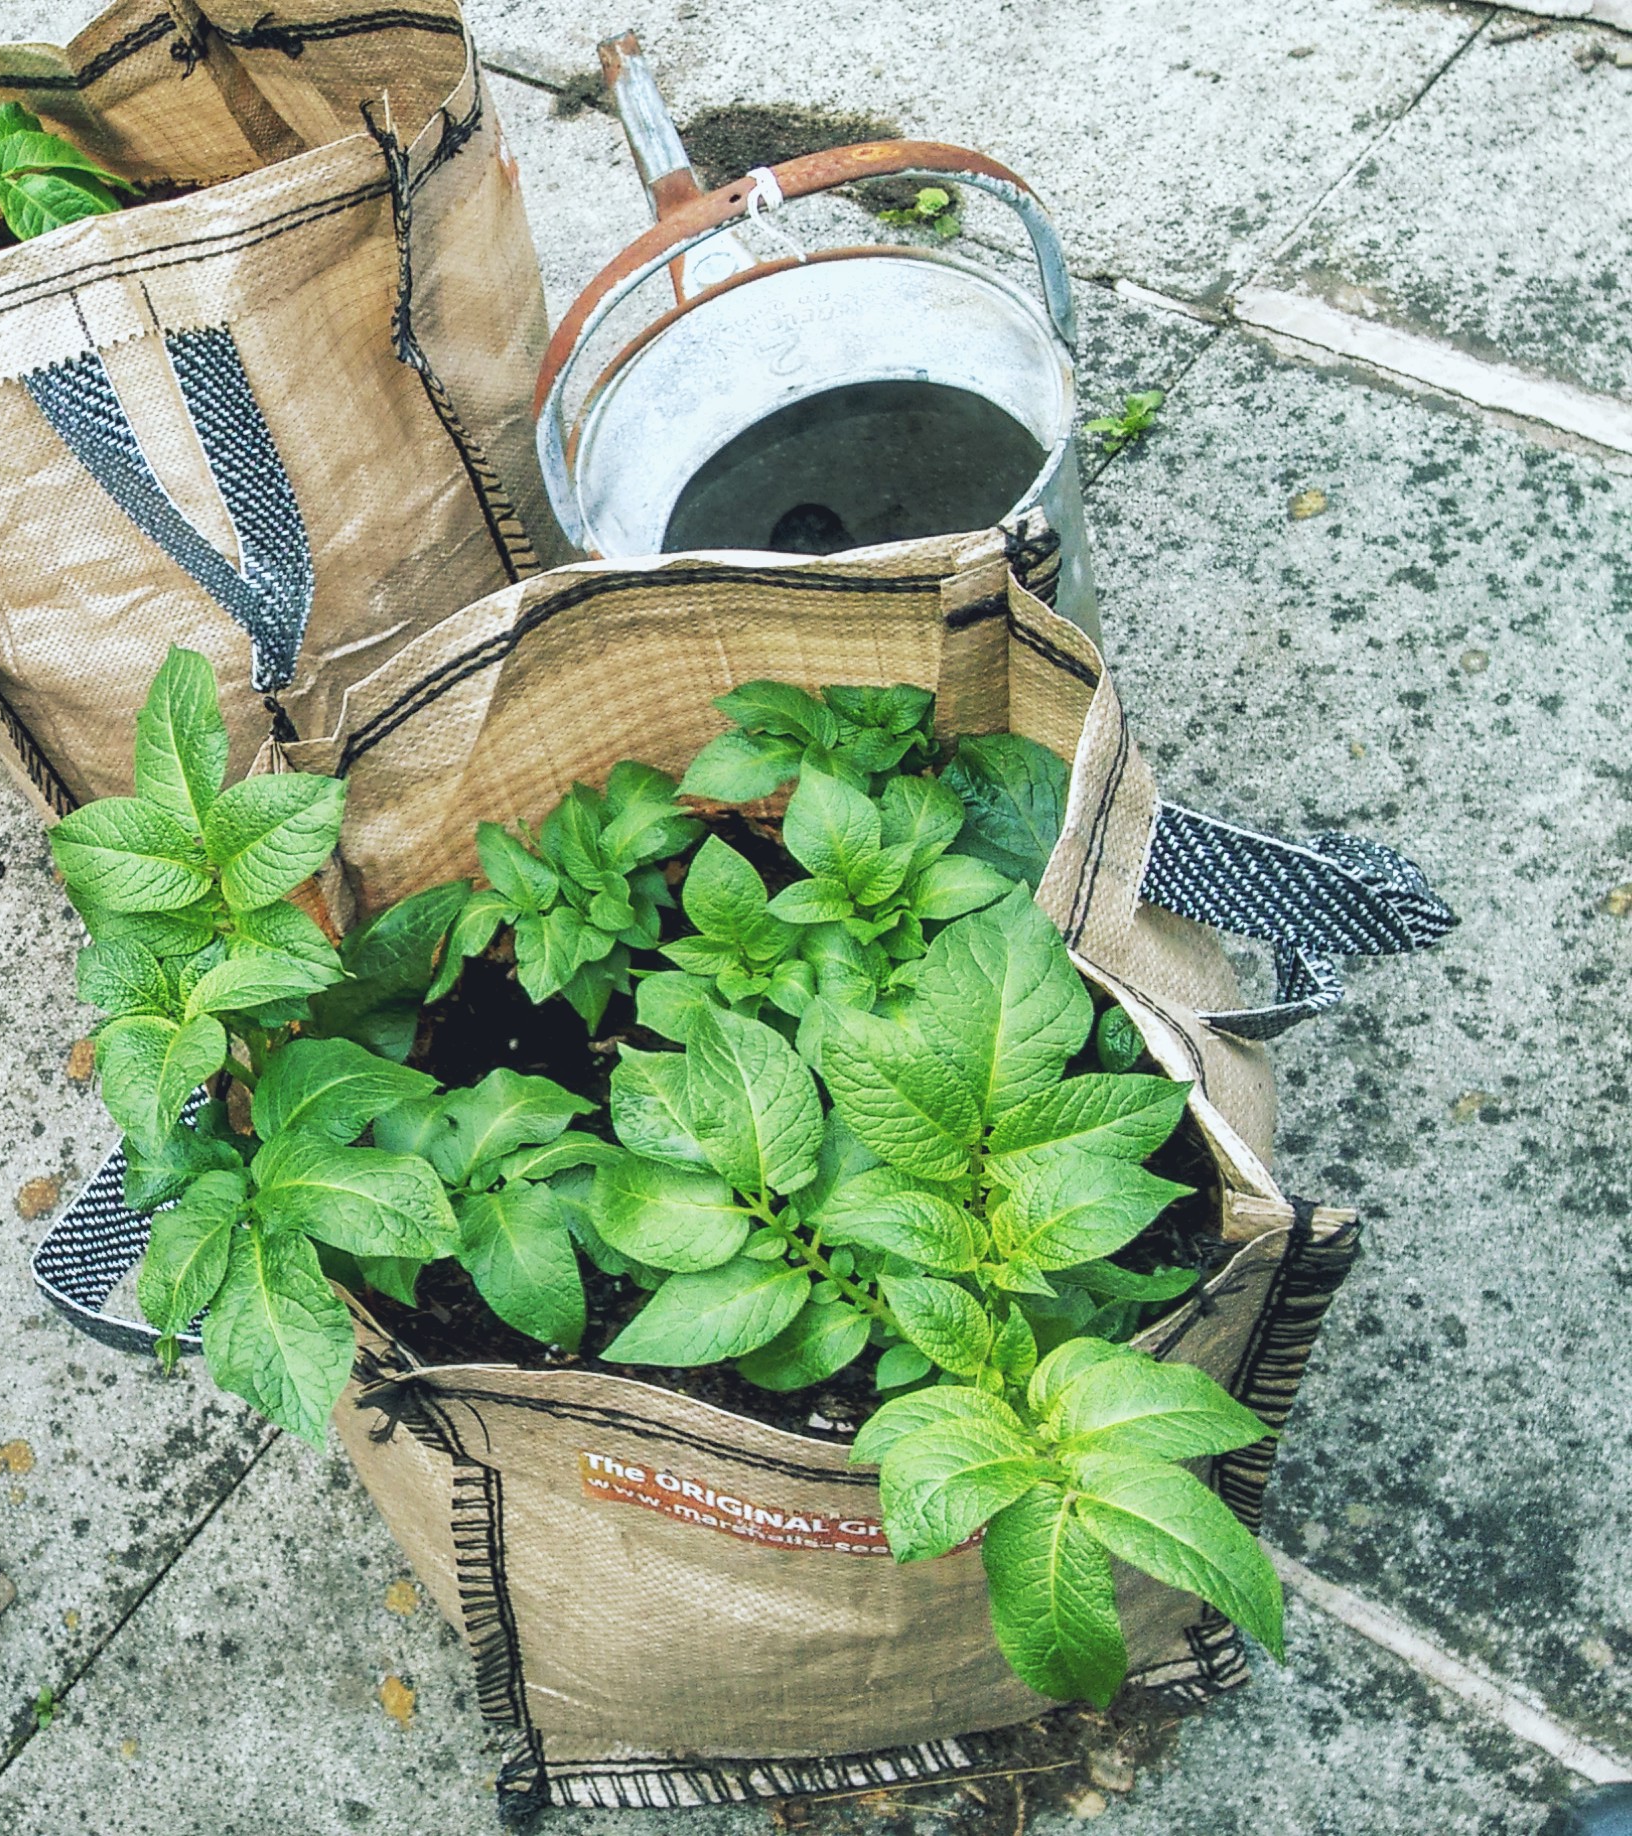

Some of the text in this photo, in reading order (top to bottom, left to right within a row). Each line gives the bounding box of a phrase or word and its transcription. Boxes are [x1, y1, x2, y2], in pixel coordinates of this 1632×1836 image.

[582, 1451, 883, 1537] The ORIGINAL Gr
[587, 1477, 889, 1553] www.marshalls-see
